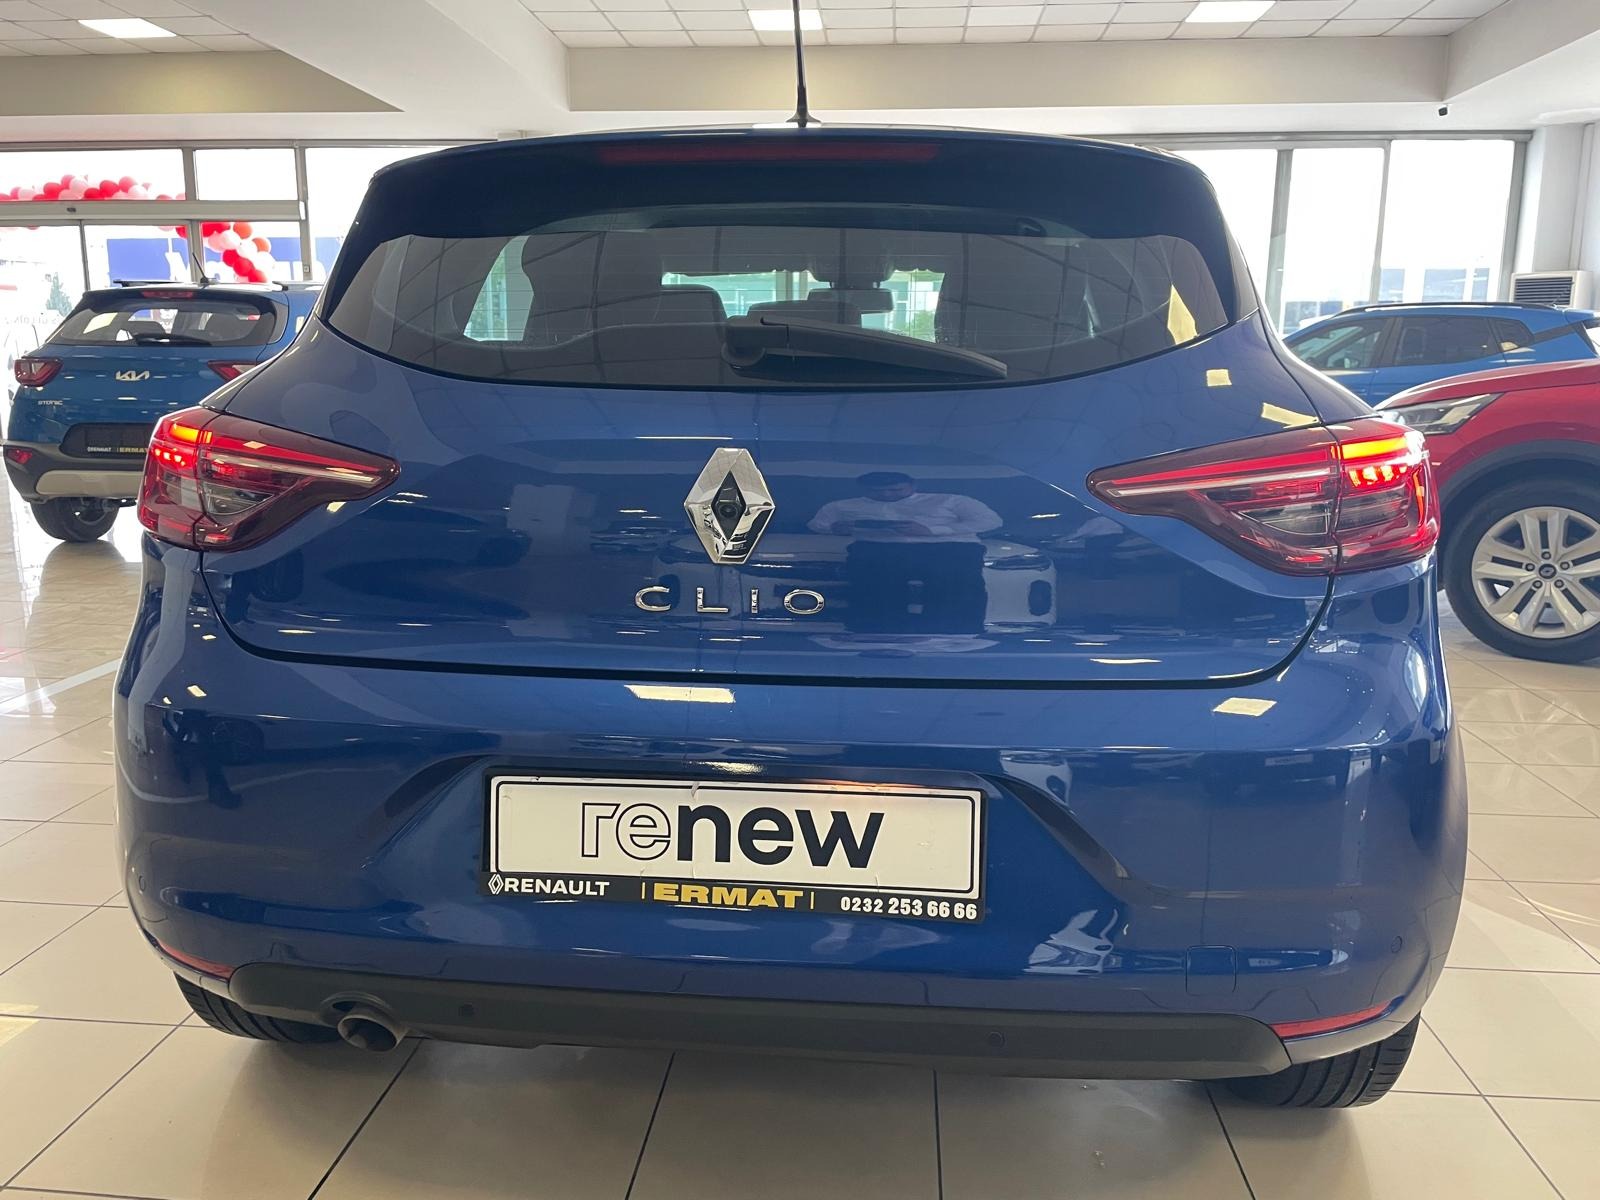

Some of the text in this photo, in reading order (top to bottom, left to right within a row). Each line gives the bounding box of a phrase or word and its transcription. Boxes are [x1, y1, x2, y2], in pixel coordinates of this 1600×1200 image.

[115, 370, 150, 381] KIA
[634, 586, 825, 615] CLIO
[581, 802, 885, 869] renew
[504, 877, 978, 920] RENAULT ERMAT 0232 253 66 66
